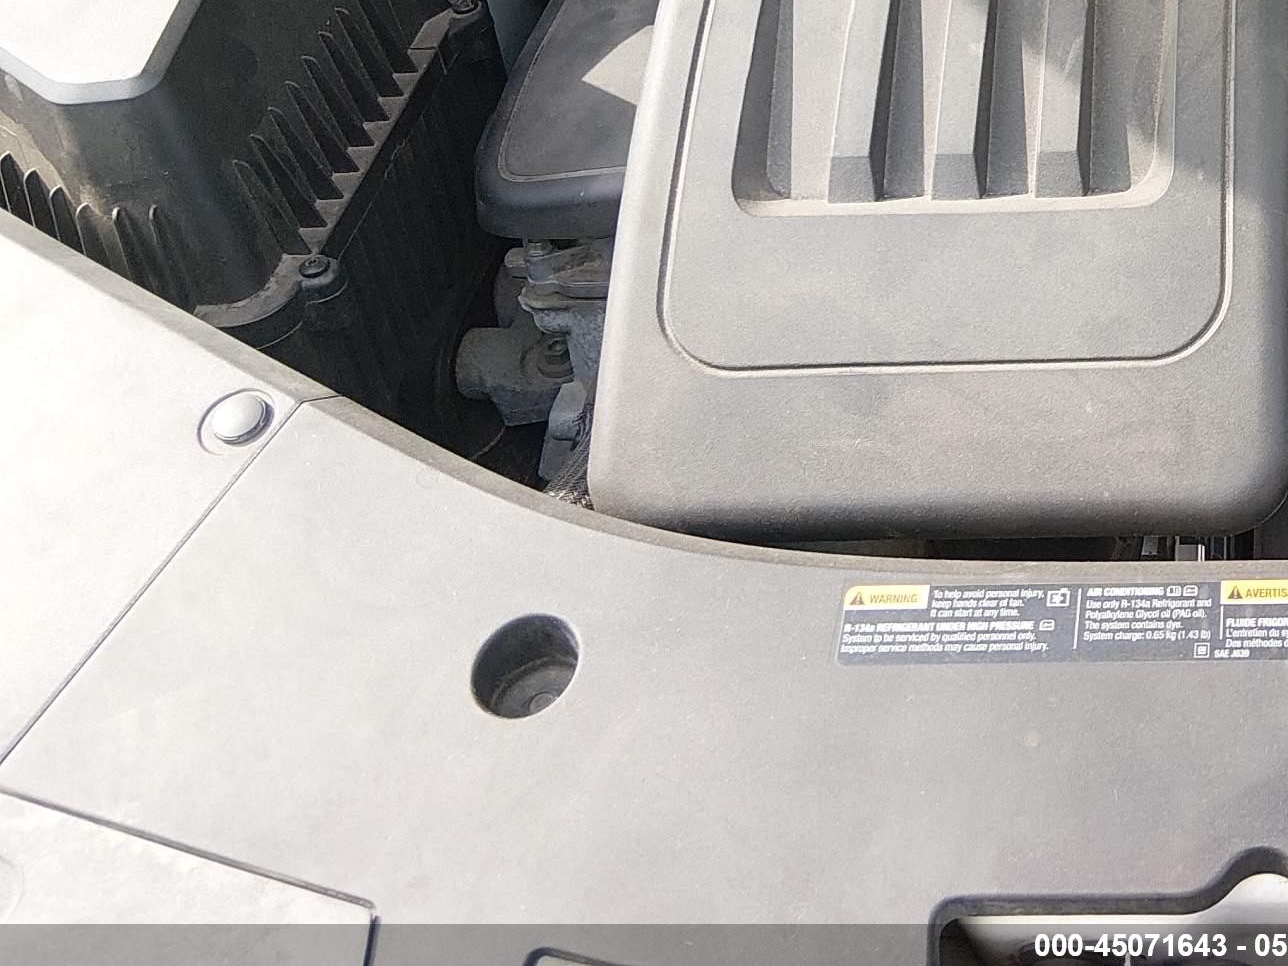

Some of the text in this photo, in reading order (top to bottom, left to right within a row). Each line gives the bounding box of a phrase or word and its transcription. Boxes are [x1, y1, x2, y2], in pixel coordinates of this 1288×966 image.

[934, 590, 1045, 599] To help avoid personal injury,
[1087, 588, 1102, 596] AIR
[870, 594, 917, 604] WARNING
[932, 600, 951, 608] keep
[979, 599, 997, 607] clear
[1000, 599, 1007, 607] of
[1009, 599, 1024, 607] fan.
[1086, 599, 1212, 610] Use only R-134a Refrigerant and
[930, 609, 936, 617] It
[954, 609, 972, 617] start
[983, 610, 998, 619] any
[1000, 609, 1020, 617] time.
[1136, 610, 1159, 619] Glycol
[1161, 610, 1170, 618] oil
[1172, 609, 1191, 619] (PAG
[1193, 609, 1208, 618] oil).
[844, 624, 875, 632] R-134a
[936, 622, 965, 632] UNDER
[967, 622, 988, 631] HIGH
[990, 621, 1035, 630] PRESSURE
[1085, 621, 1099, 629] The
[1101, 621, 1130, 630] system
[1131, 620, 1165, 629] contains
[1226, 618, 1257, 627] FLUIDE
[1084, 630, 1211, 642] System charge: 0.65 kg (1.43 lb)
[1269, 628, 1280, 637] du
[843, 632, 1037, 644] System to be serviced by qualified personnel only.
[1225, 639, 1241, 648] Des
[1243, 638, 1283, 647] méthodes
[841, 644, 877, 654] Improper
[909, 644, 943, 652] methods
[945, 644, 962, 652] may
[963, 643, 988, 651] cause
[988, 642, 1023, 652] personal
[1025, 642, 1049, 652] injury.
[1215, 650, 1229, 658] SAE
